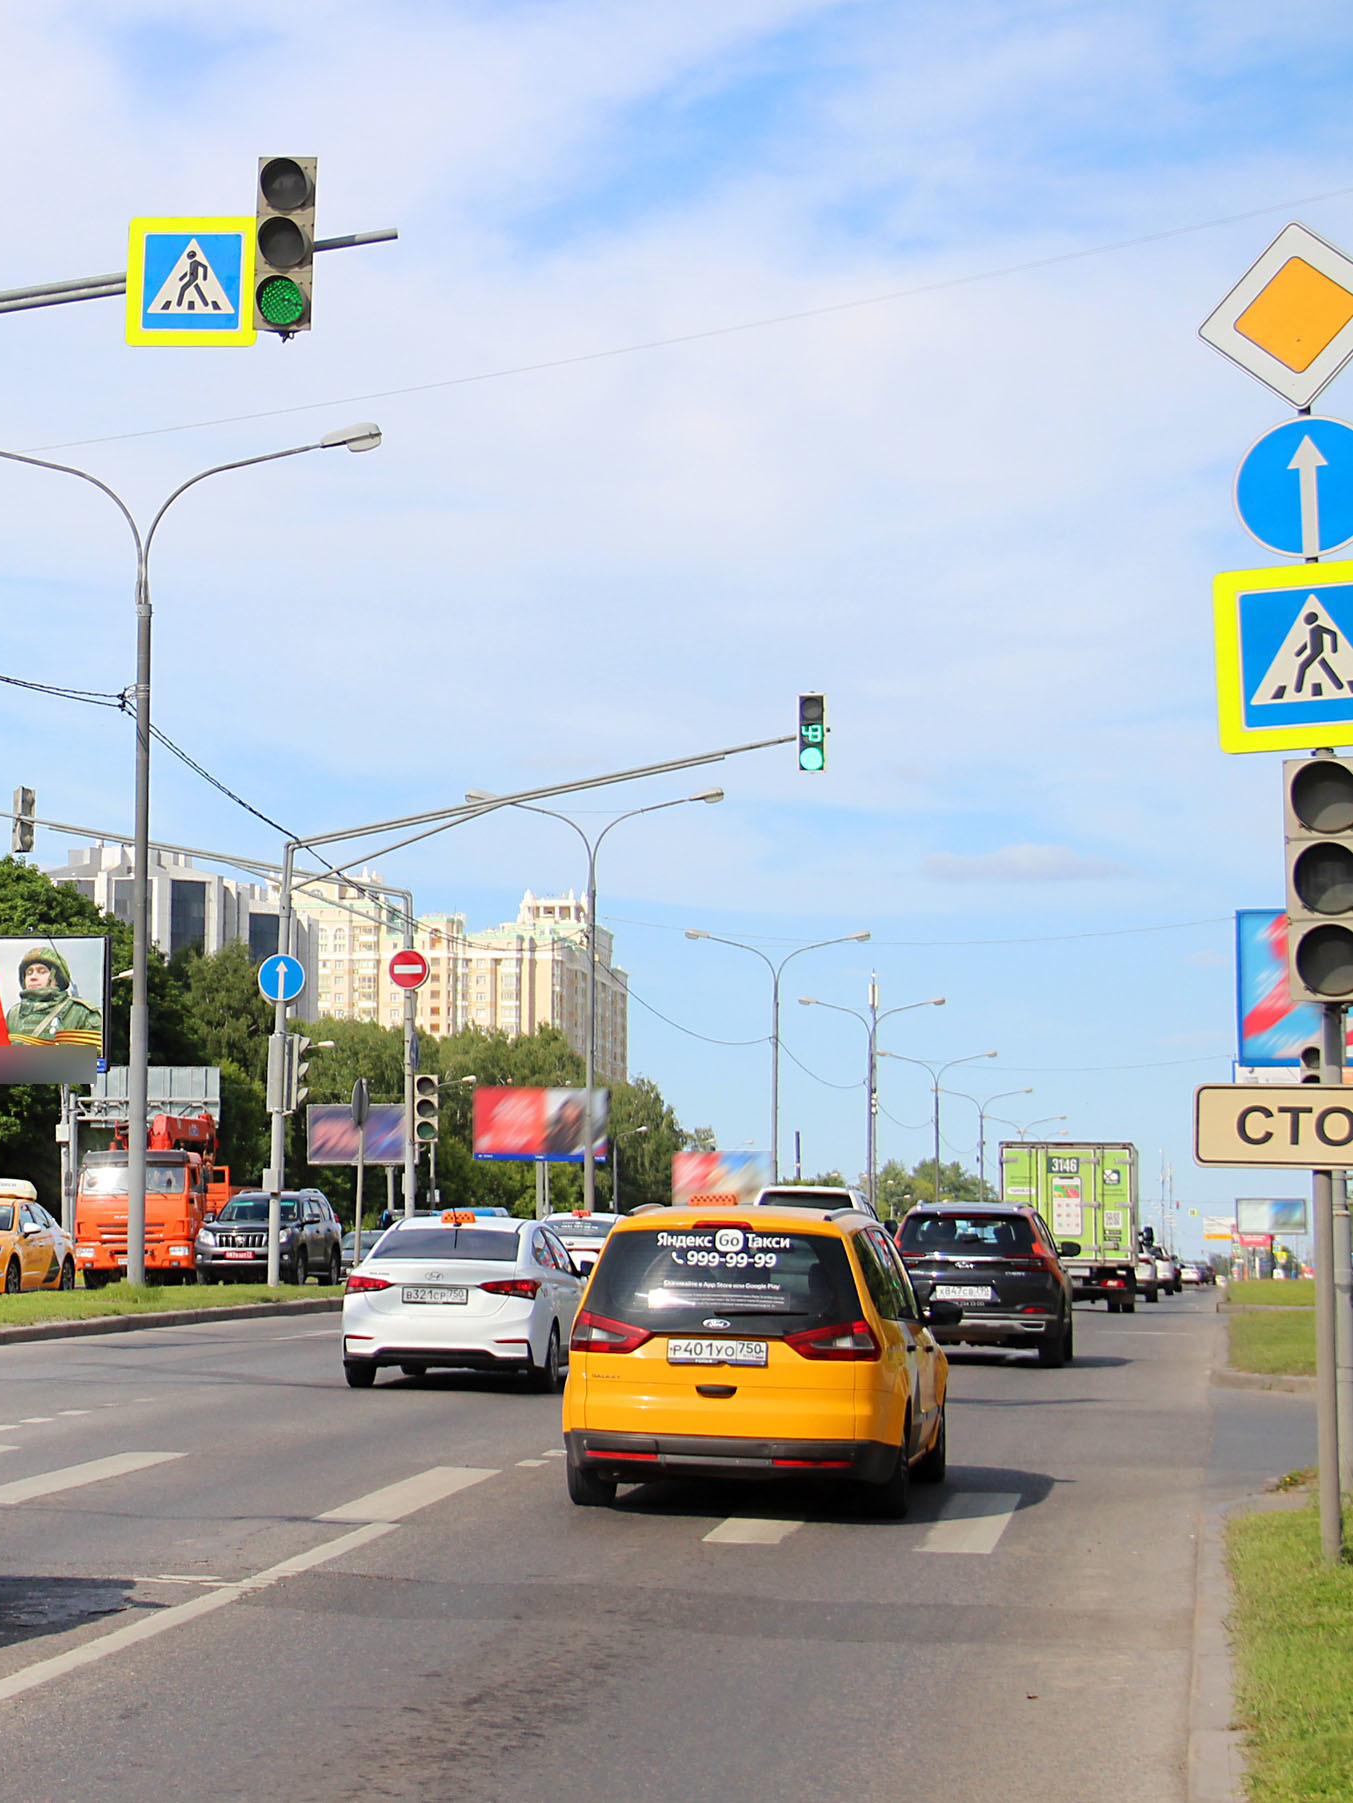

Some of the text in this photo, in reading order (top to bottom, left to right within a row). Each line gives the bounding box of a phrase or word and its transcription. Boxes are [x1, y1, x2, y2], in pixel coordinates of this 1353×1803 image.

[1236, 1105, 1353, 1147] СТО
[1051, 1158, 1077, 1172] 3146
[657, 1232, 790, 1249] Яндекс Go Такси
[687, 1250, 777, 1268] 999-99-99
[738, 1342, 762, 1354] 750
